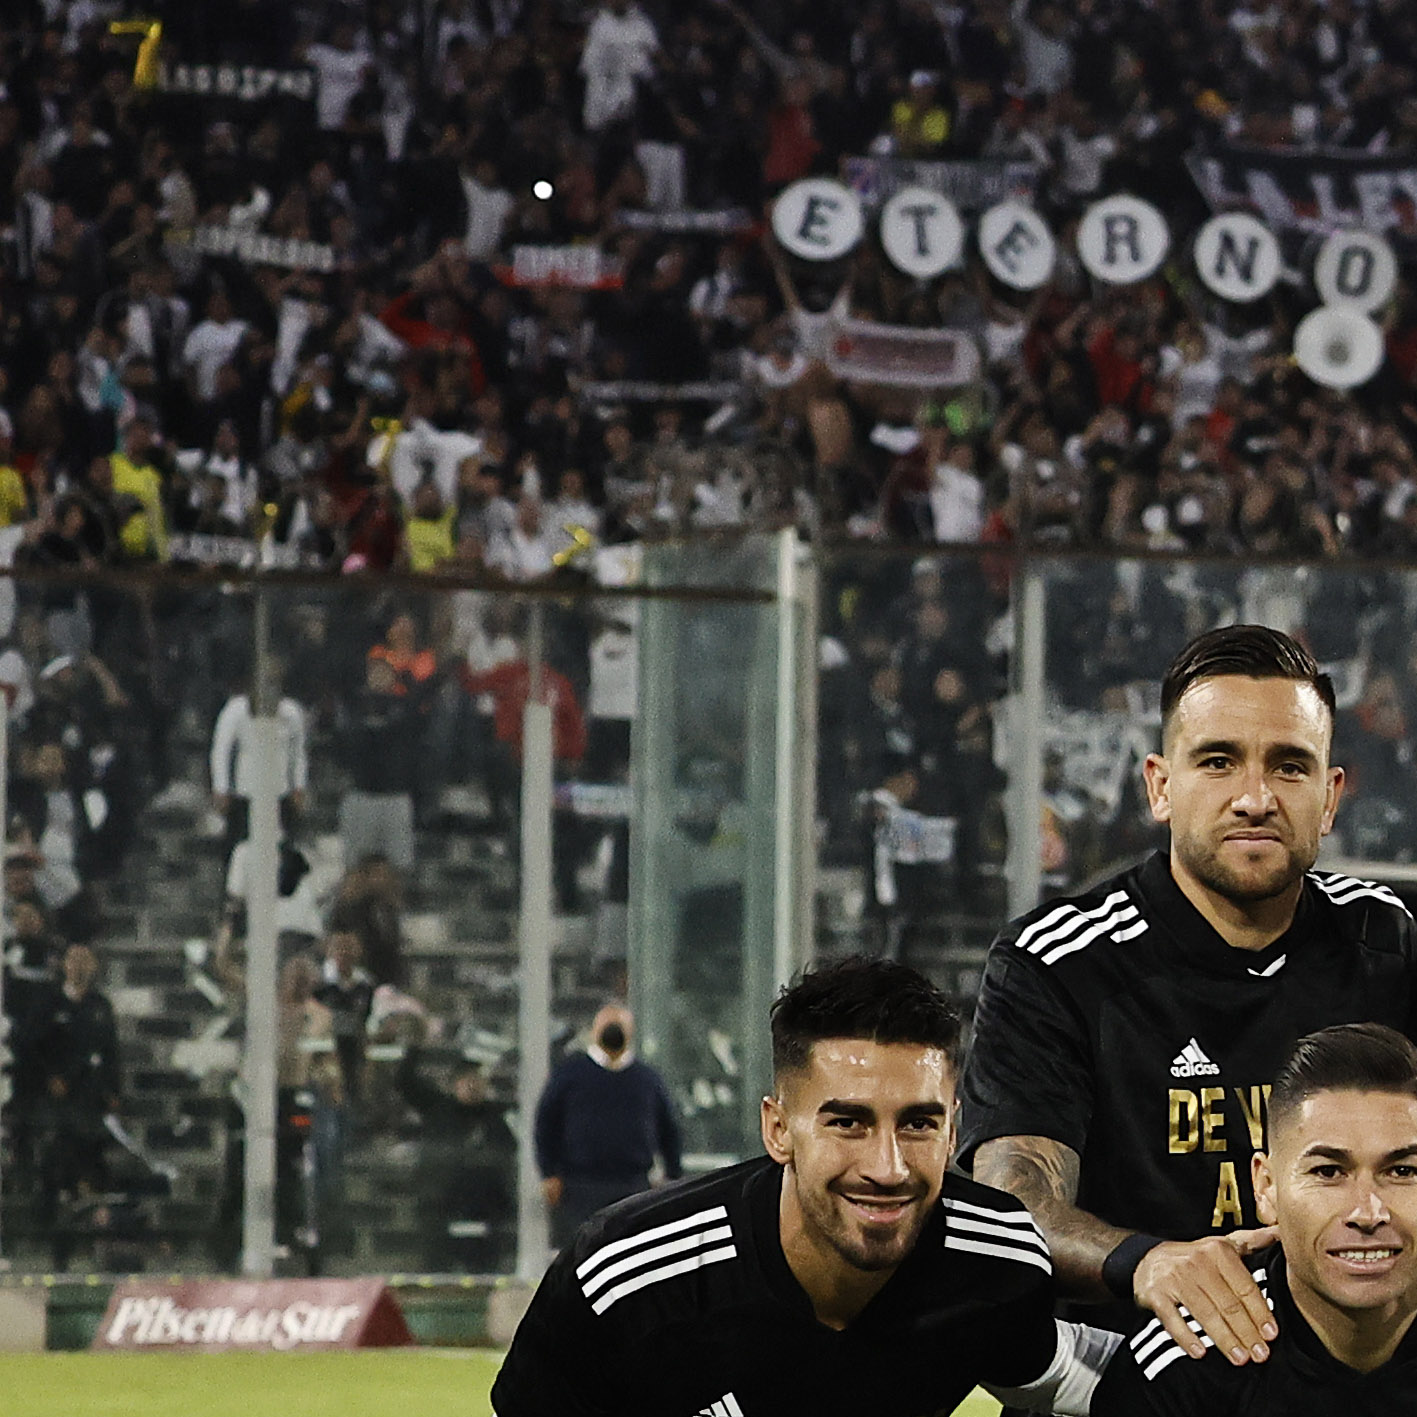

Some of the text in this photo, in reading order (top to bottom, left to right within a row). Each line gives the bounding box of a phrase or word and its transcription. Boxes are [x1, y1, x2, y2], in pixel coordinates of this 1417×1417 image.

[1169, 1061, 1221, 1078] adidas
[1167, 1086, 1228, 1154] DE
[1210, 1160, 1244, 1228] A
